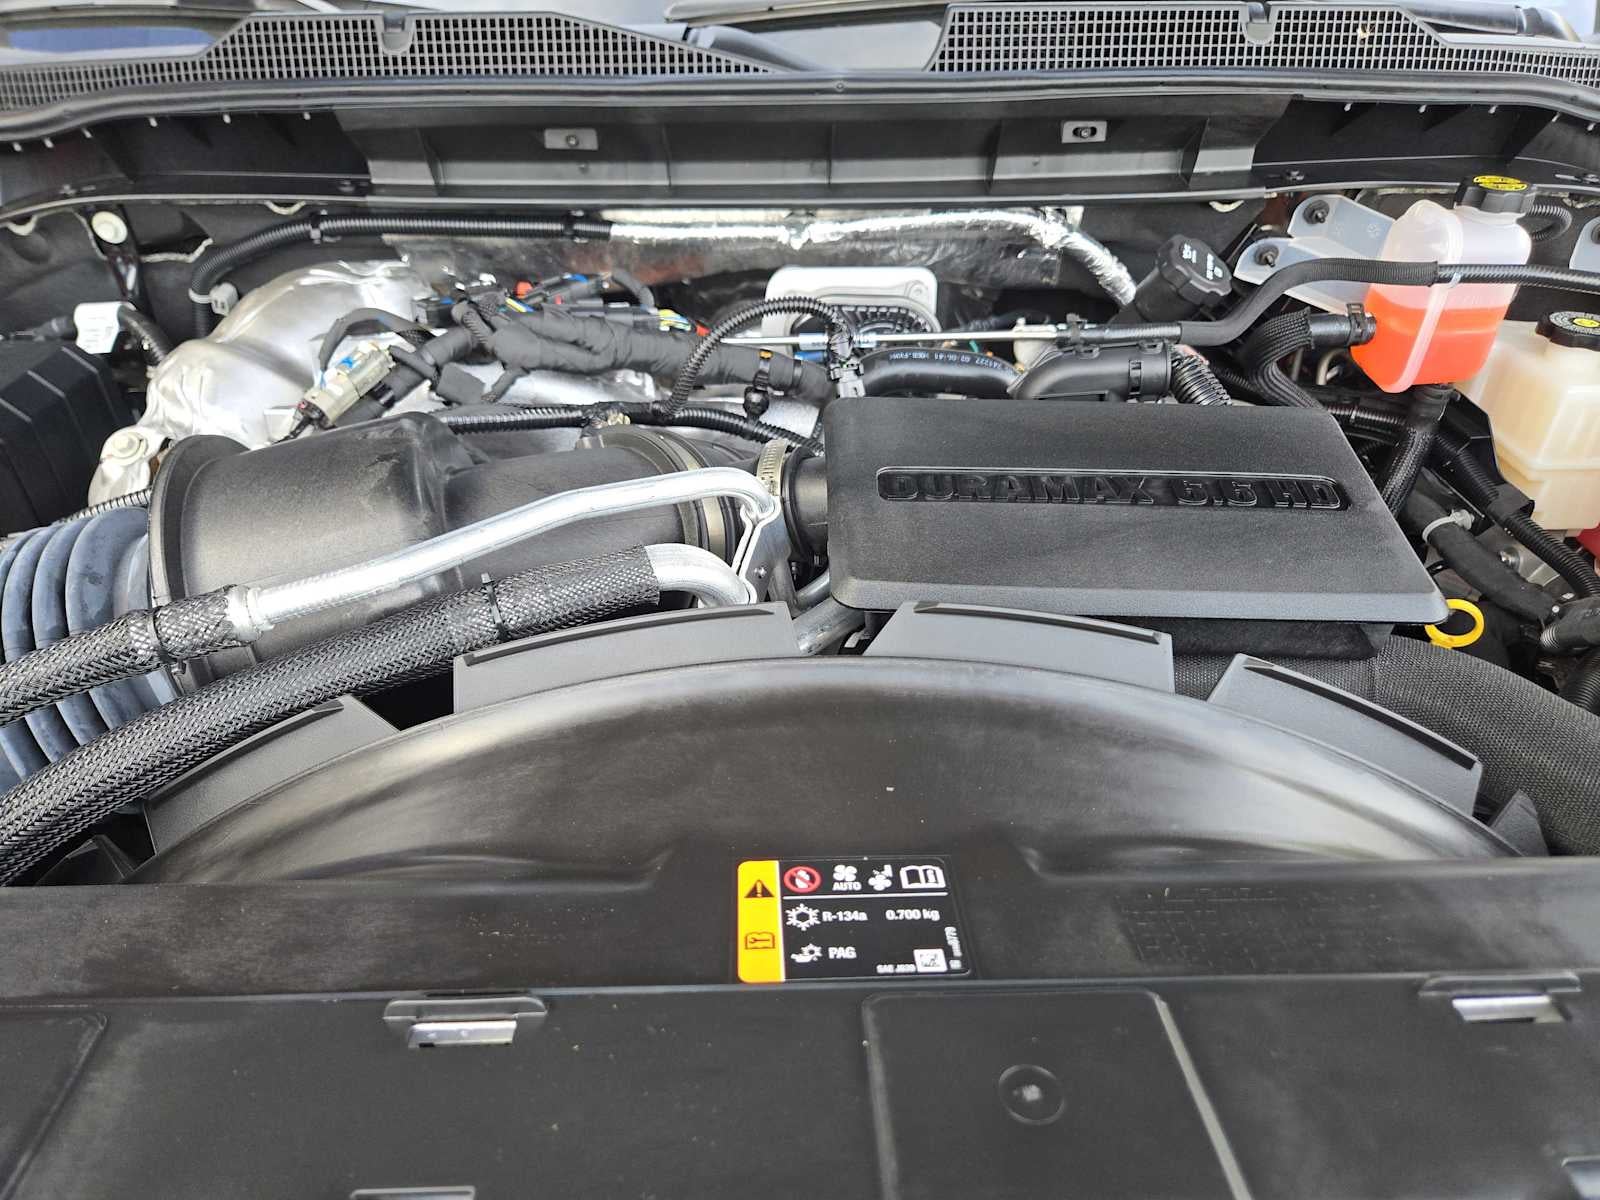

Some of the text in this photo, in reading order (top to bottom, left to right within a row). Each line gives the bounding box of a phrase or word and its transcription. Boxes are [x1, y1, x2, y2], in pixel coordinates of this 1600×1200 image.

[886, 474, 1154, 504] DURAMAX
[1266, 480, 1341, 510] HD
[832, 881, 862, 891] AUTO
[822, 907, 940, 922] R-134a 0.700 kg
[828, 946, 857, 959] PAG
